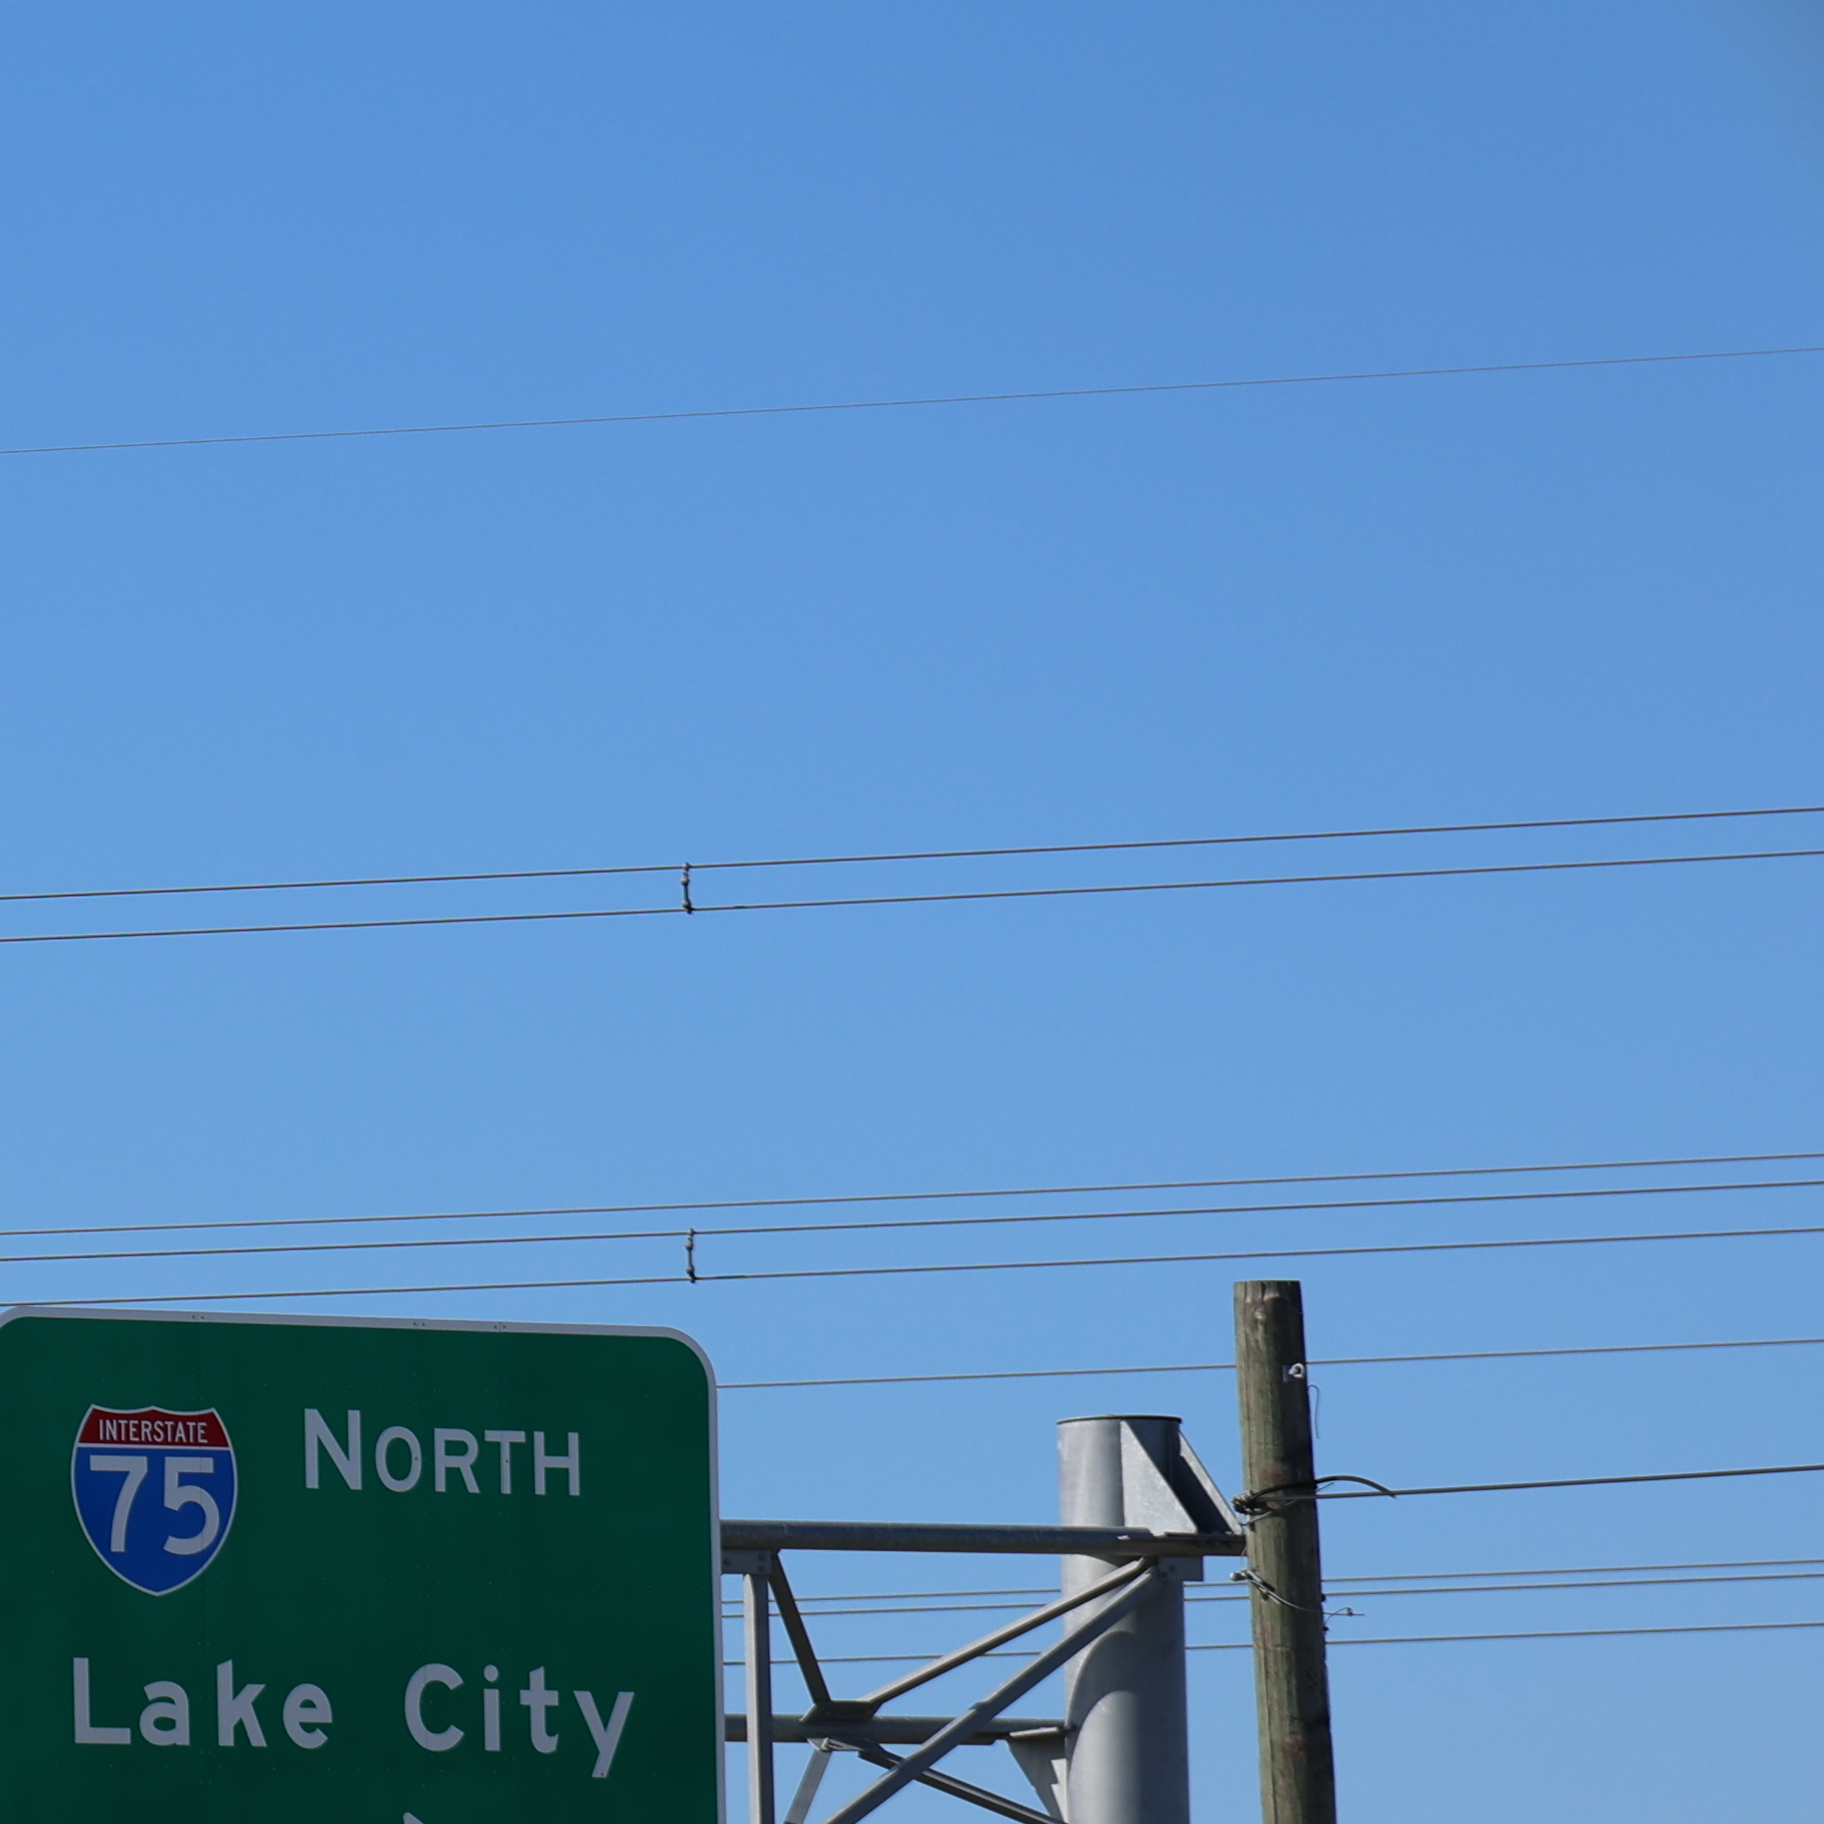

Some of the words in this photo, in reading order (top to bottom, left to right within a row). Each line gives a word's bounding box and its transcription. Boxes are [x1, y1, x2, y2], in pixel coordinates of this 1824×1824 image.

[98, 1419, 209, 1444] INTERSTATE
[304, 1408, 580, 1497] NORTH
[89, 1454, 221, 1556] 75
[73, 1657, 333, 1750] Lake
[404, 1663, 635, 1779] City
